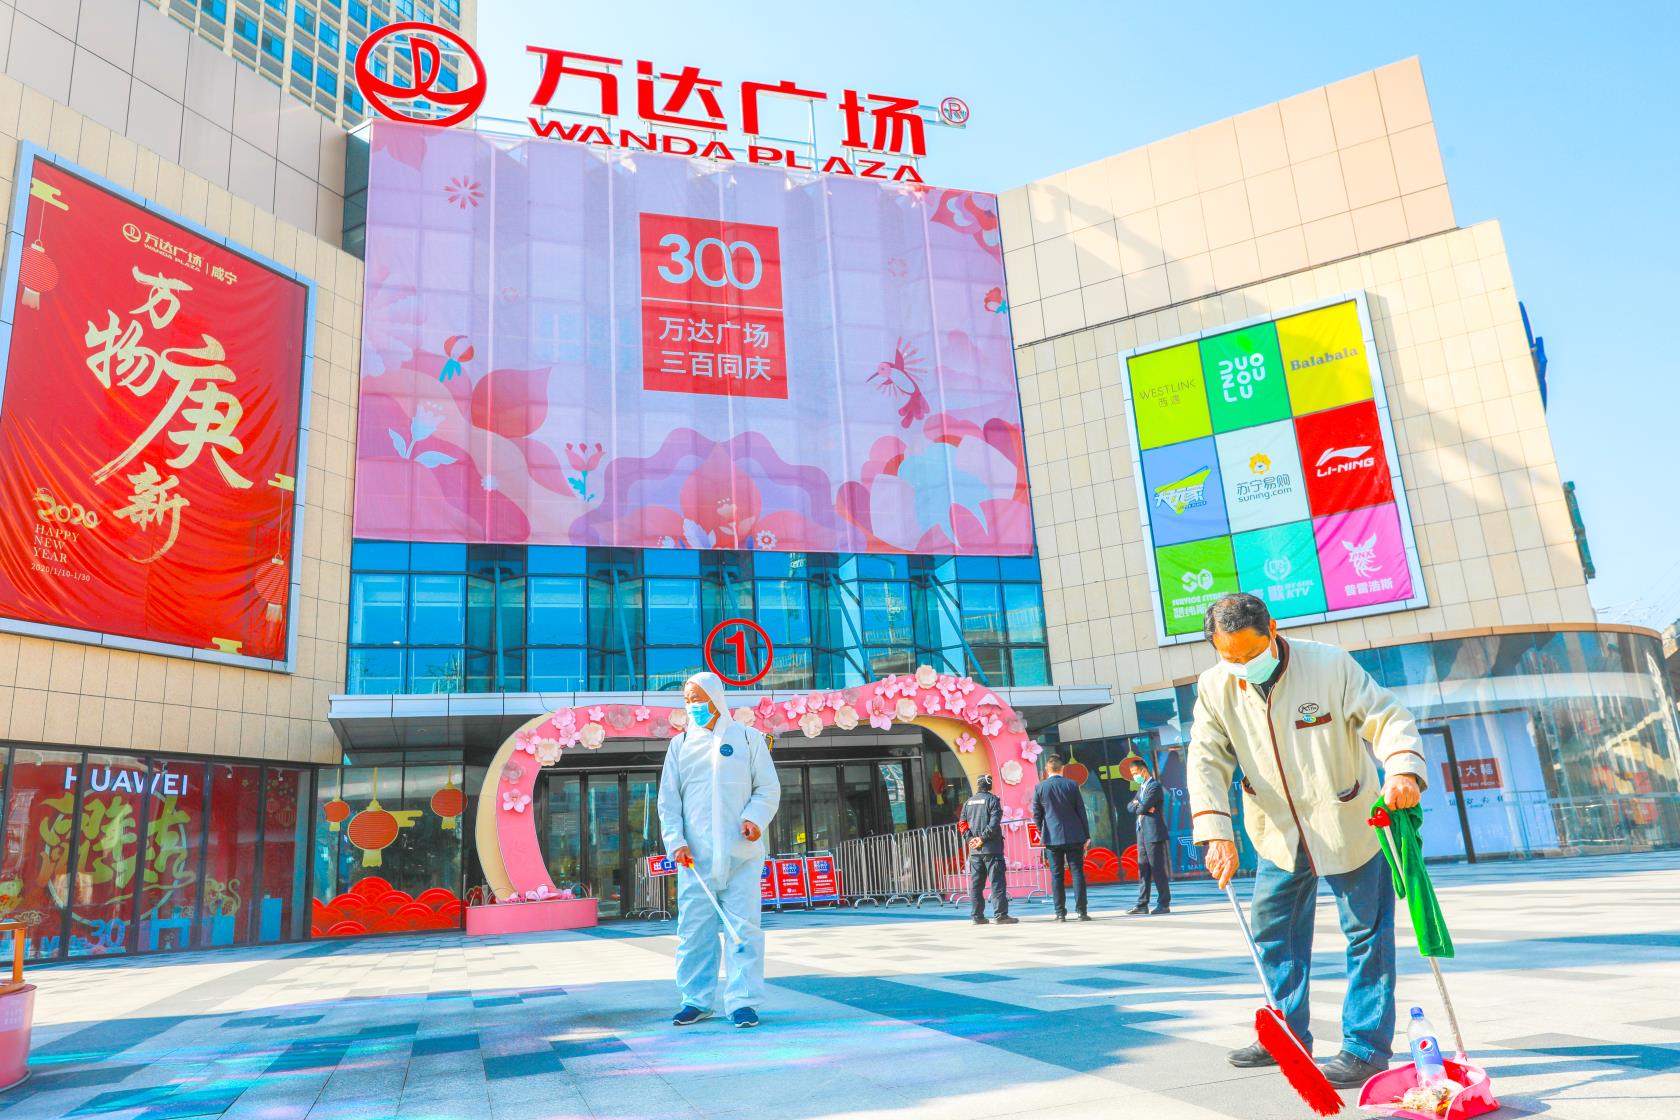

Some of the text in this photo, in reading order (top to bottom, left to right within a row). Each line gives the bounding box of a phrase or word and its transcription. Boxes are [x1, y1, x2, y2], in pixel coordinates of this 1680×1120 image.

[525, 45, 927, 157] 万达广场
[527, 116, 925, 184] WANDA PLAZA
[144, 231, 238, 285] 万达广场 咸宁
[144, 243, 201, 273] WANDA PLAZA
[657, 234, 763, 290] 300
[658, 316, 769, 348] 万达广场
[660, 350, 771, 381] 三百同庆
[1290, 347, 1359, 371] Balabala
[1317, 458, 1375, 477] LI-NING
[1236, 474, 1291, 496] 苏宁易购
[1238, 486, 1293, 503] suning.com
[33, 488, 98, 529] 2020
[34, 535, 65, 550] NEW
[35, 524, 80, 542] HAPPY
[33, 546, 67, 563] YEAR
[31, 562, 91, 582] 2020/1/10-1/30
[64, 766, 188, 796] HUAWEI
[653, 861, 672, 871] 出口
